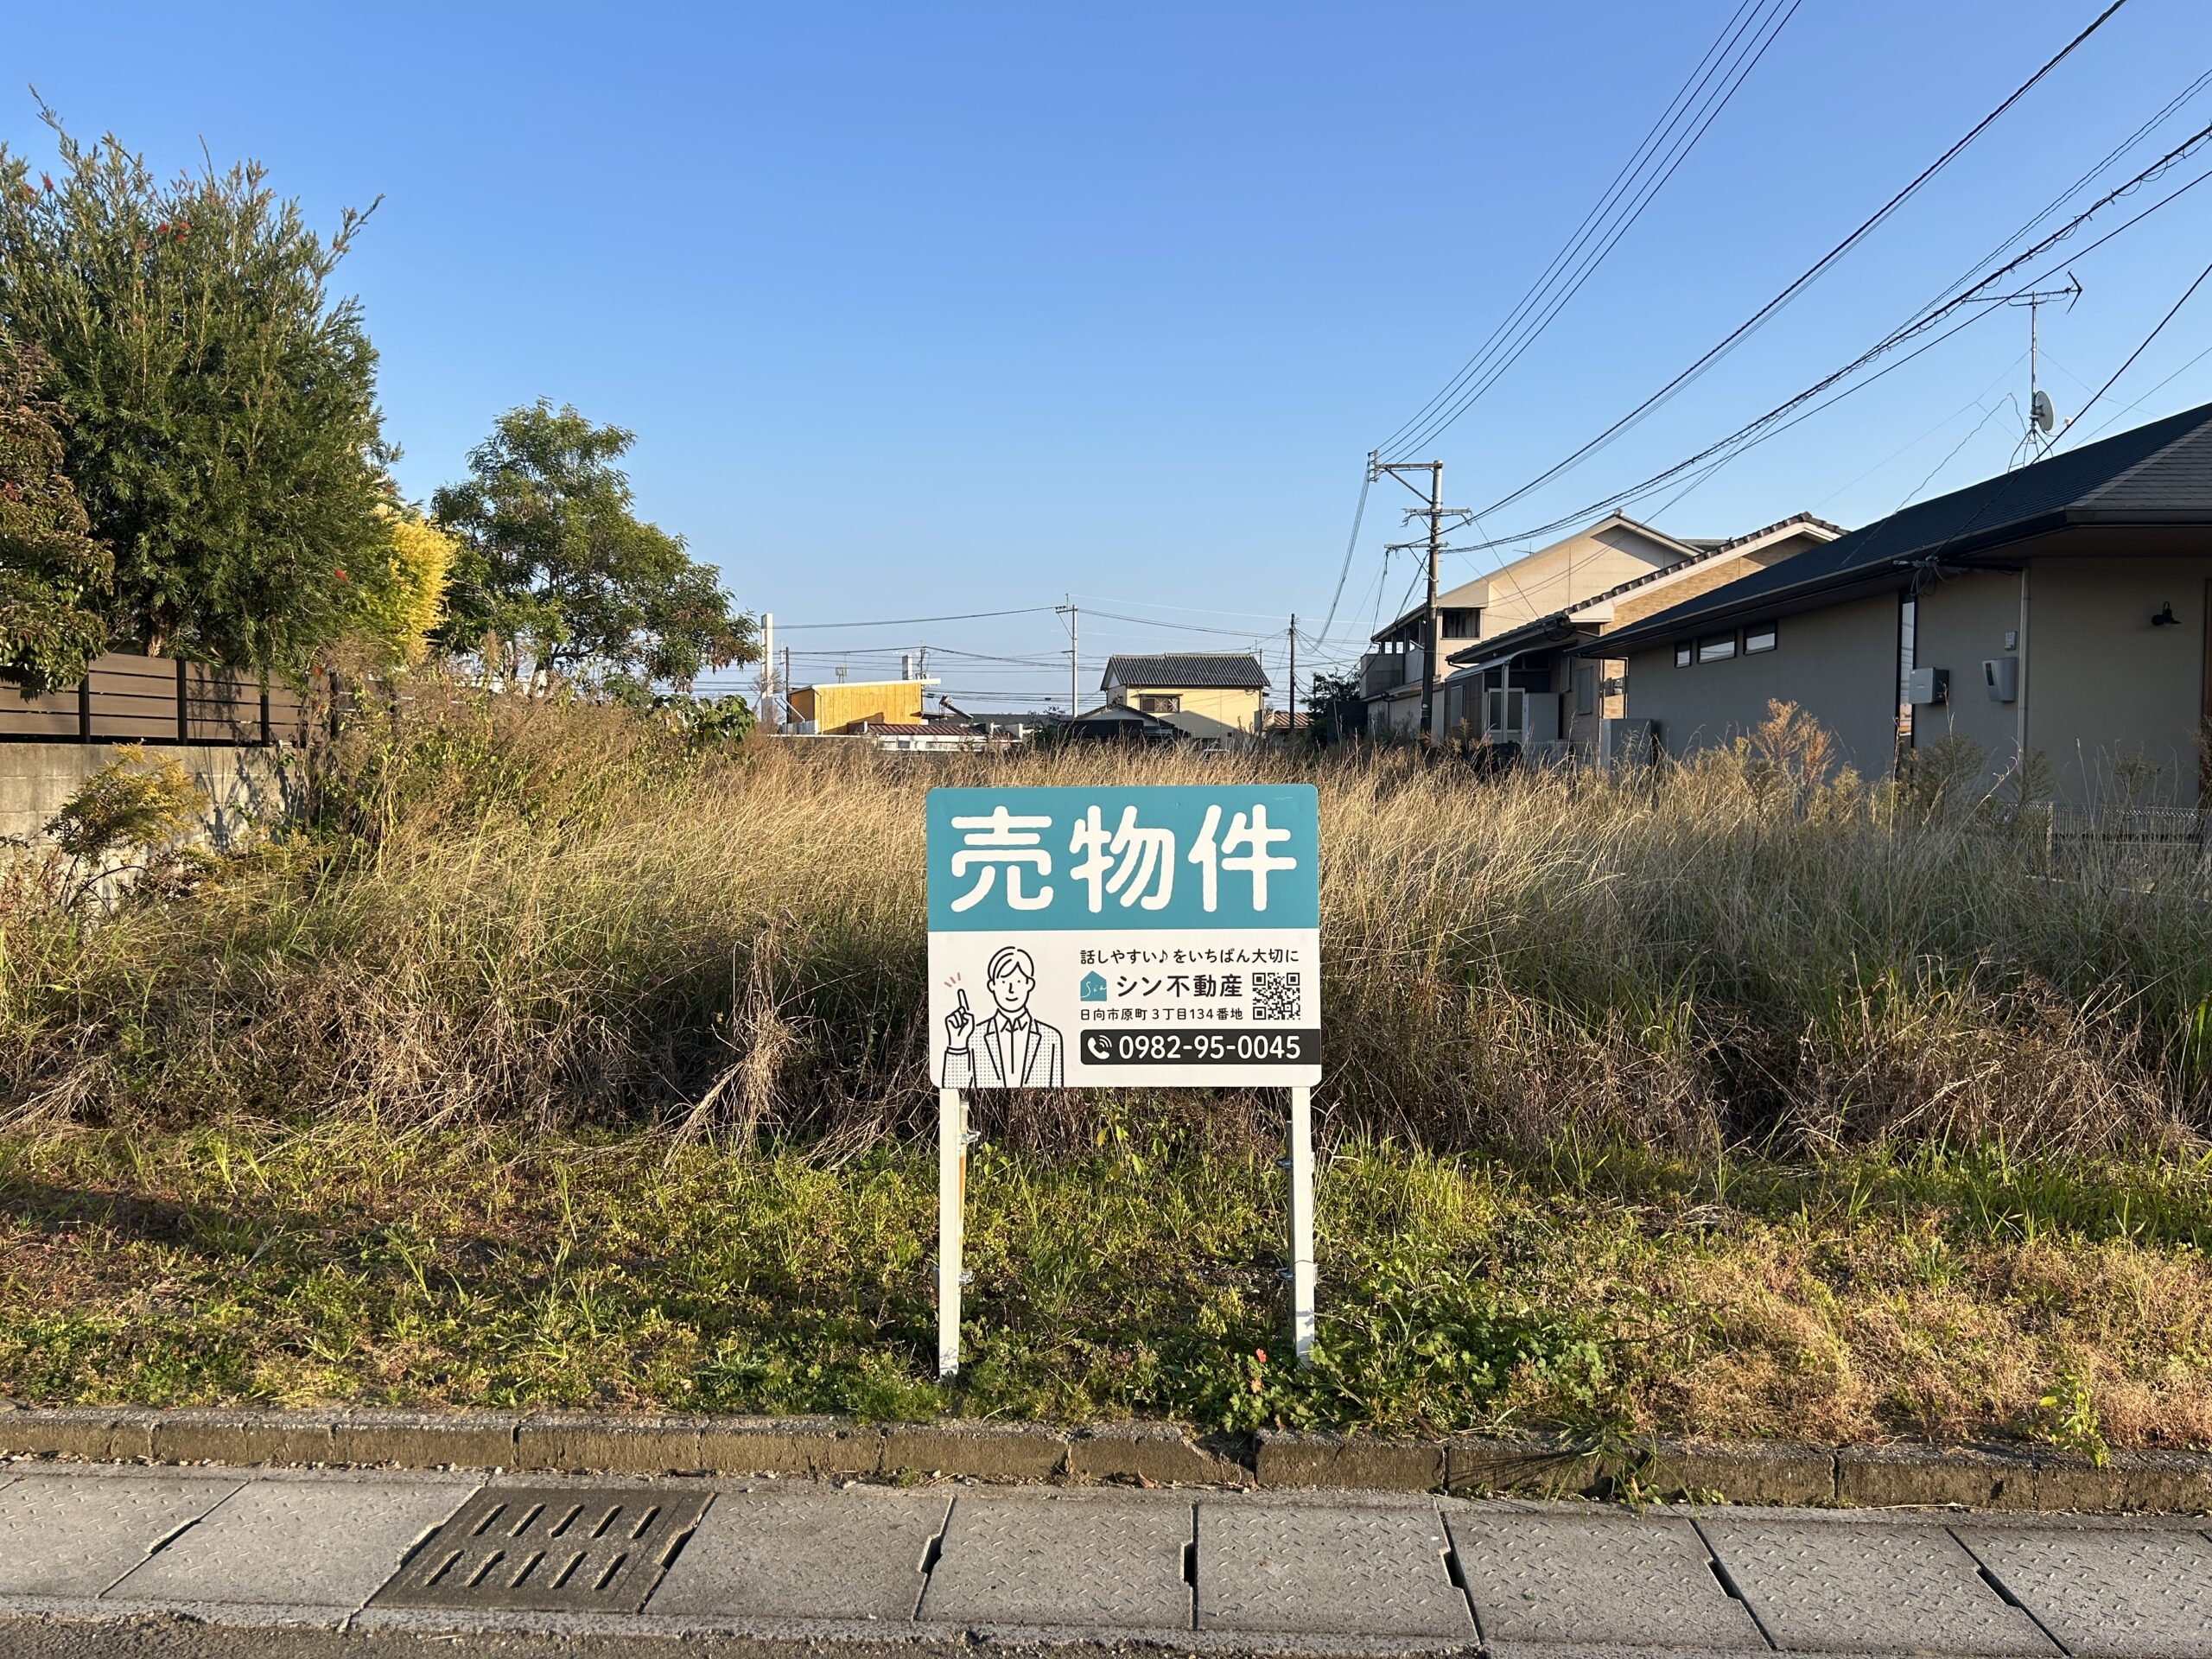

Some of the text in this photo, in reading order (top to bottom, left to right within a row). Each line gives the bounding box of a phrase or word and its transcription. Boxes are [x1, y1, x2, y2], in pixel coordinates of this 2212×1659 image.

[950, 804, 1297, 912] 売物件
[1116, 973, 1243, 997] シン不動産
[1119, 1034, 1301, 1060] 0982-95-0045
